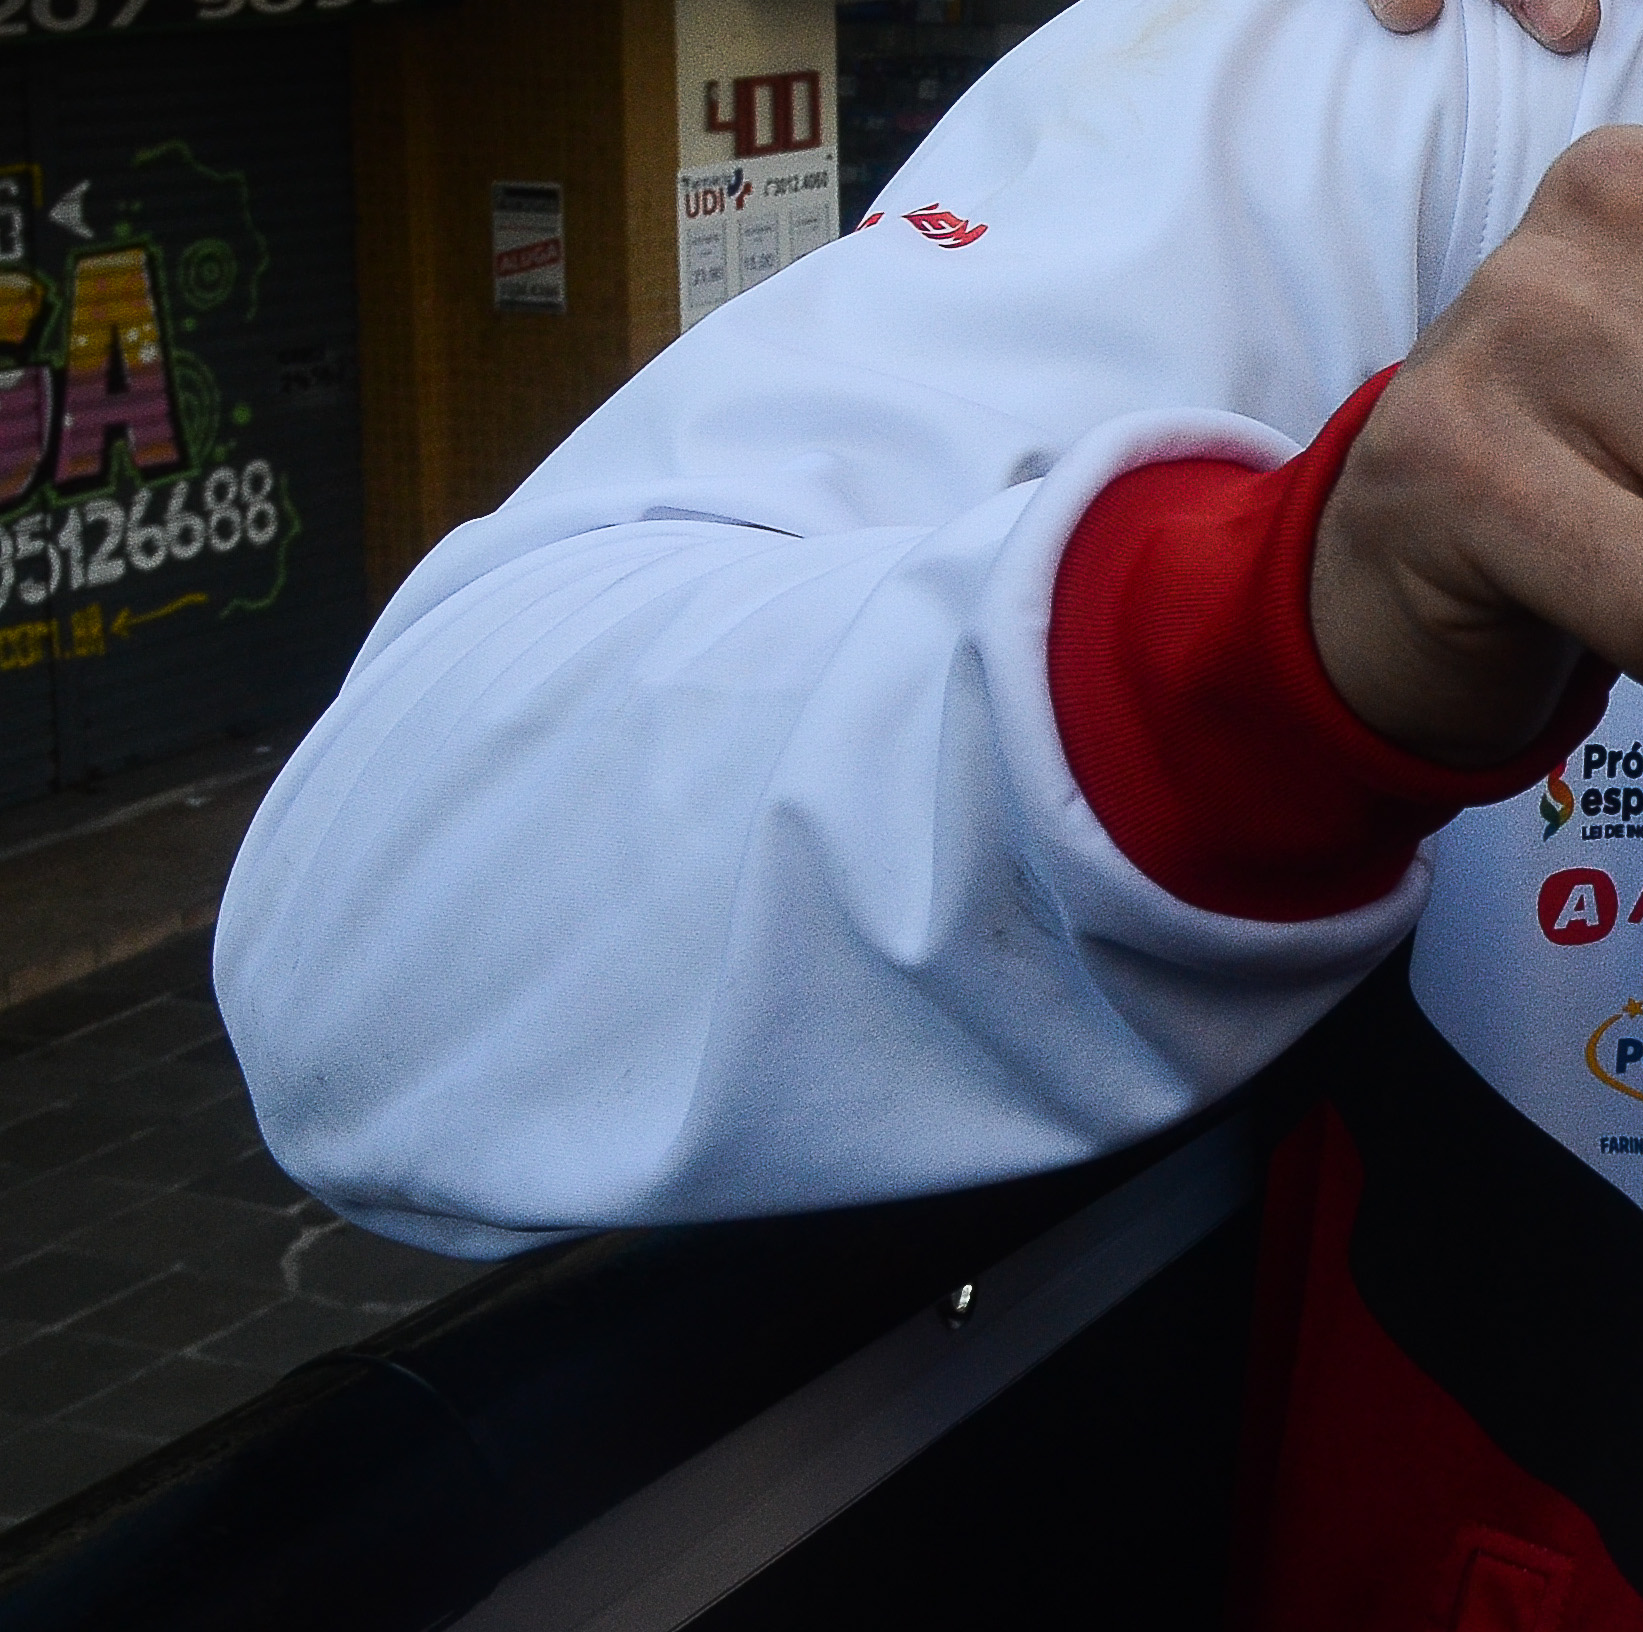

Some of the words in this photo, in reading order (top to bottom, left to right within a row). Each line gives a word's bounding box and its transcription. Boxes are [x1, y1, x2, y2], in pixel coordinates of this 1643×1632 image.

[685, 187, 725, 218] UDI
[1581, 824, 1602, 841] LEI
[1605, 824, 1625, 839] DE
